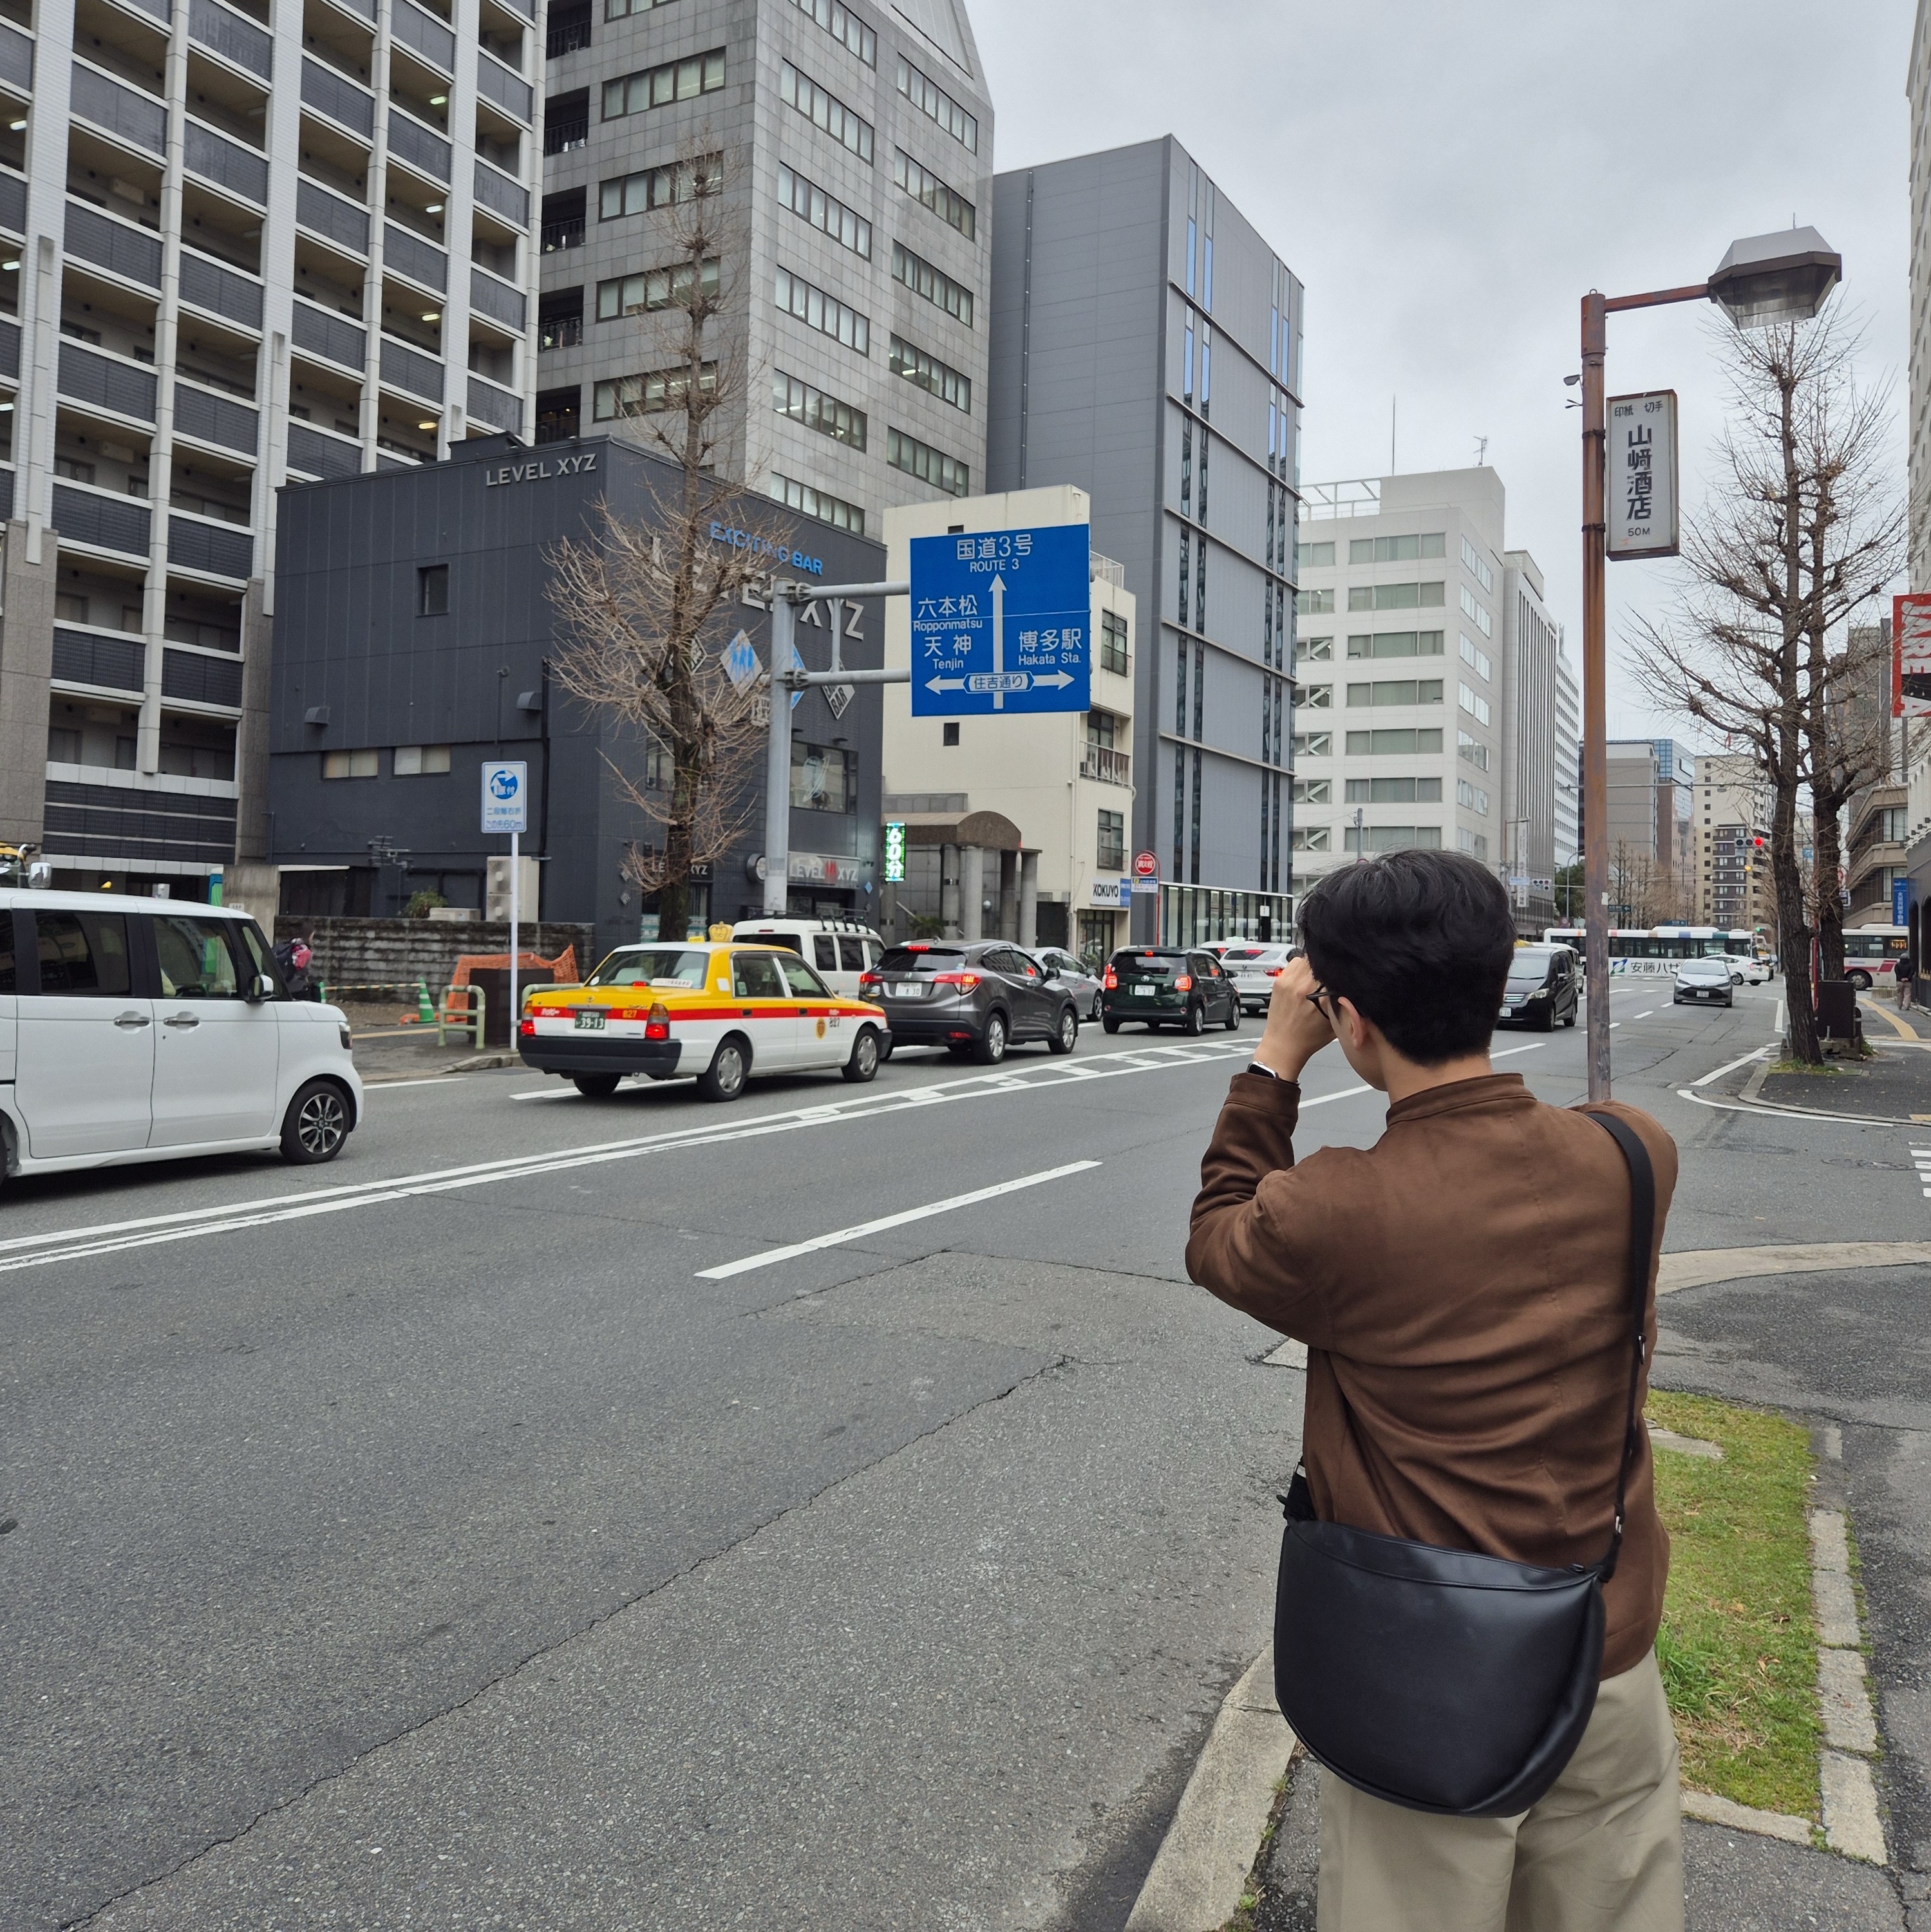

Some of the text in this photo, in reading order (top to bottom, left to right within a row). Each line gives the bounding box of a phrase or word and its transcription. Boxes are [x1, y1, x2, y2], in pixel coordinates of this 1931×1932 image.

[1615, 400, 1663, 417] 印紙 切手
[486, 453, 597, 486] LEVEL XYZ
[1628, 527, 1651, 537] 50M
[957, 534, 1033, 561] 国道3号
[791, 551, 823, 576] BAR
[970, 559, 1019, 572] ROUTE 3
[917, 594, 978, 619] 六本松
[913, 619, 983, 633] Ropponmatsu
[1019, 628, 1082, 652] 博多駅
[932, 659, 964, 671] Tenjin
[1019, 652, 1081, 665] Hakata Sta.
[974, 675, 1023, 690] 住吉通り
[789, 863, 858, 881] LEVEL XYZ
[1093, 884, 1118, 897] KOKUYO
